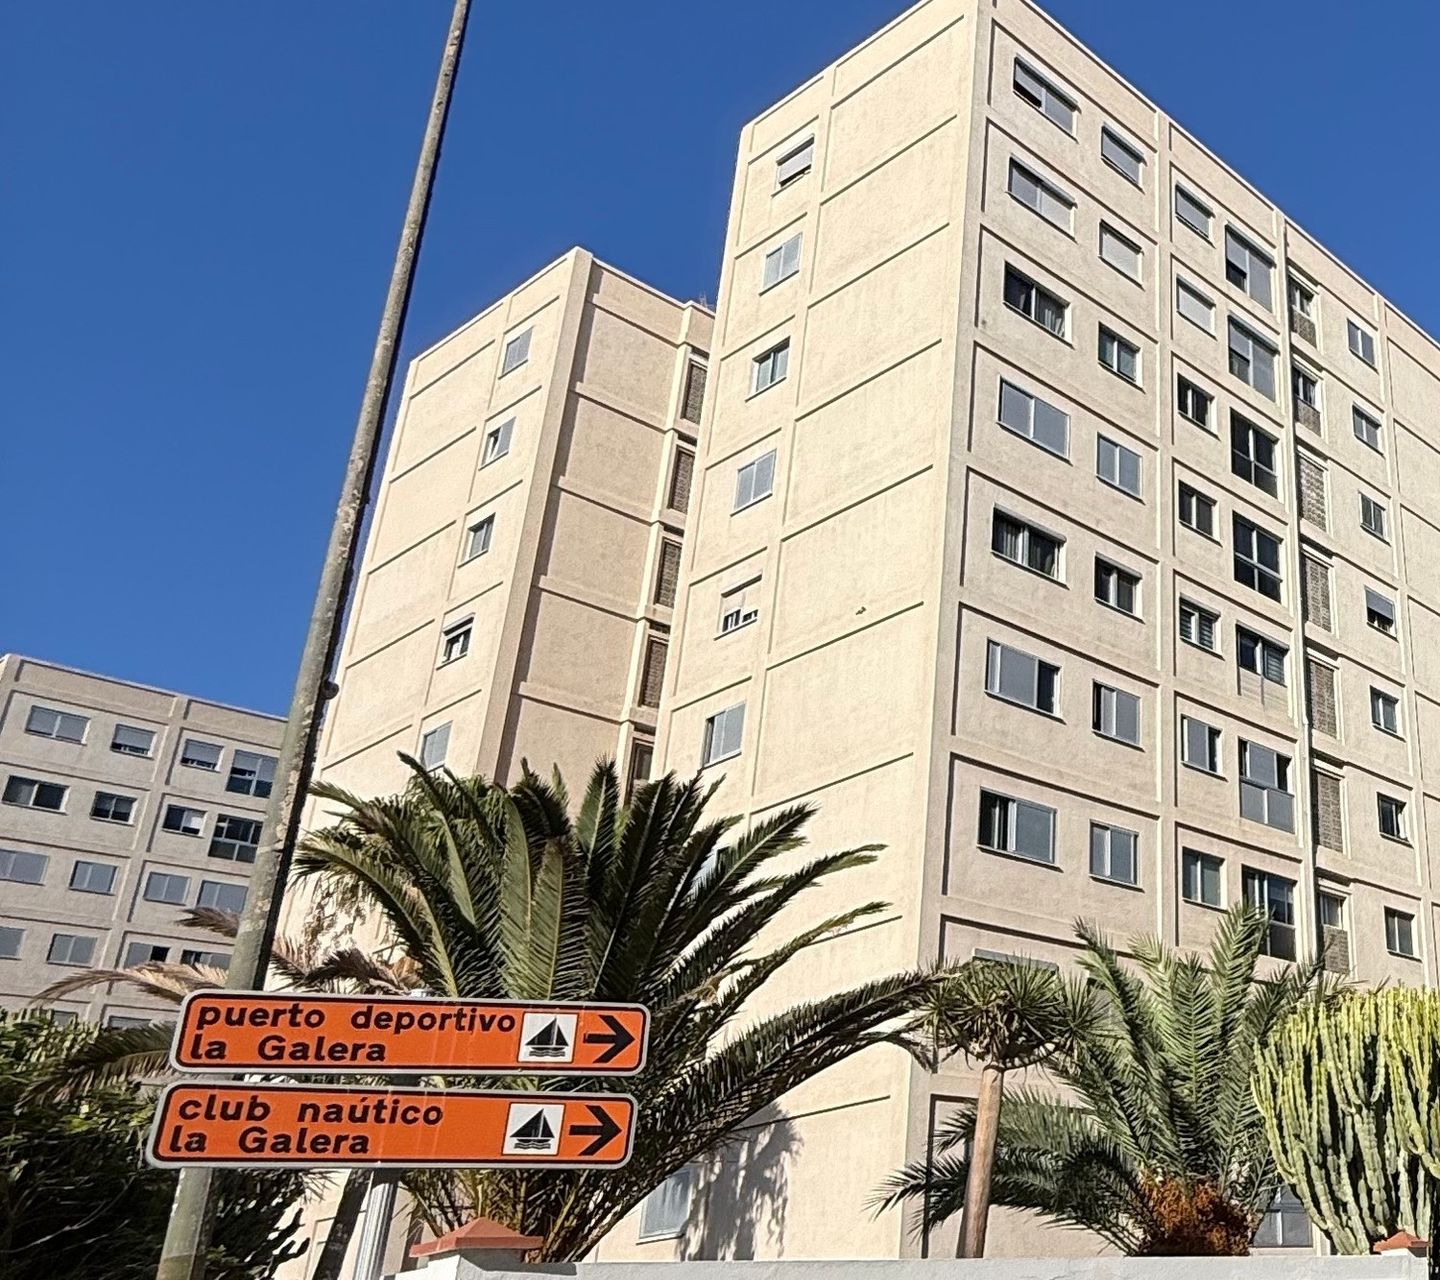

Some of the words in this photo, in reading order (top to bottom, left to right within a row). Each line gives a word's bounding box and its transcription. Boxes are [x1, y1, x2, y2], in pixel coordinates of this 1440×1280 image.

[197, 1003, 326, 1030] puerto
[350, 1005, 516, 1035] deportivo
[190, 1034, 227, 1060] la
[257, 1035, 386, 1062] Galera
[178, 1094, 271, 1122] club
[297, 1097, 443, 1126] naútico
[169, 1125, 206, 1153] la
[238, 1126, 370, 1154] Galera
